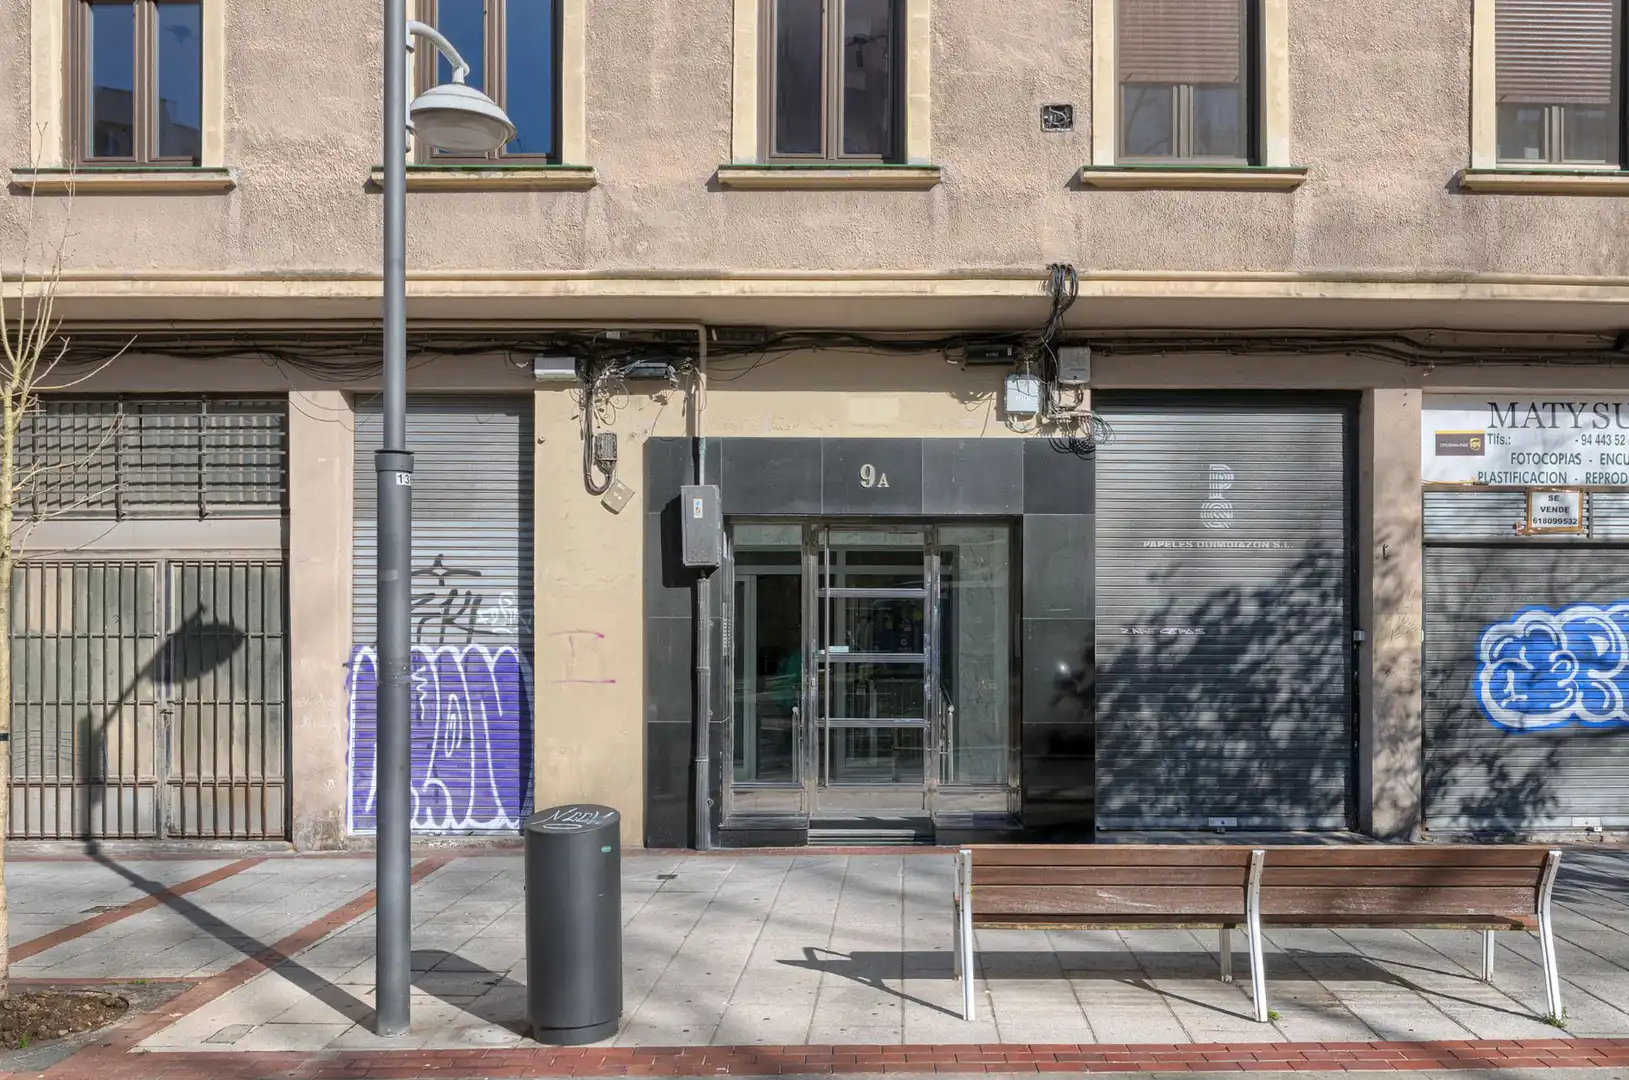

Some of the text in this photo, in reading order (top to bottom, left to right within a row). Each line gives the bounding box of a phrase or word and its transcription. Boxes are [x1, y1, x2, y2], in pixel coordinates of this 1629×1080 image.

[1580, 433, 1592, 446] 94
[1595, 433, 1612, 446] 443
[1614, 433, 1626, 446] 52
[1510, 452, 1582, 466] FOTOCOPIAS
[1599, 452, 1629, 466] ENCU
[1478, 471, 1567, 485] PLASTIFICACION
[1585, 471, 1629, 485] REPROD
[1548, 494, 1560, 502] SE
[1532, 516, 1578, 525] 618099532
[1143, 540, 1193, 548] PAPELES
